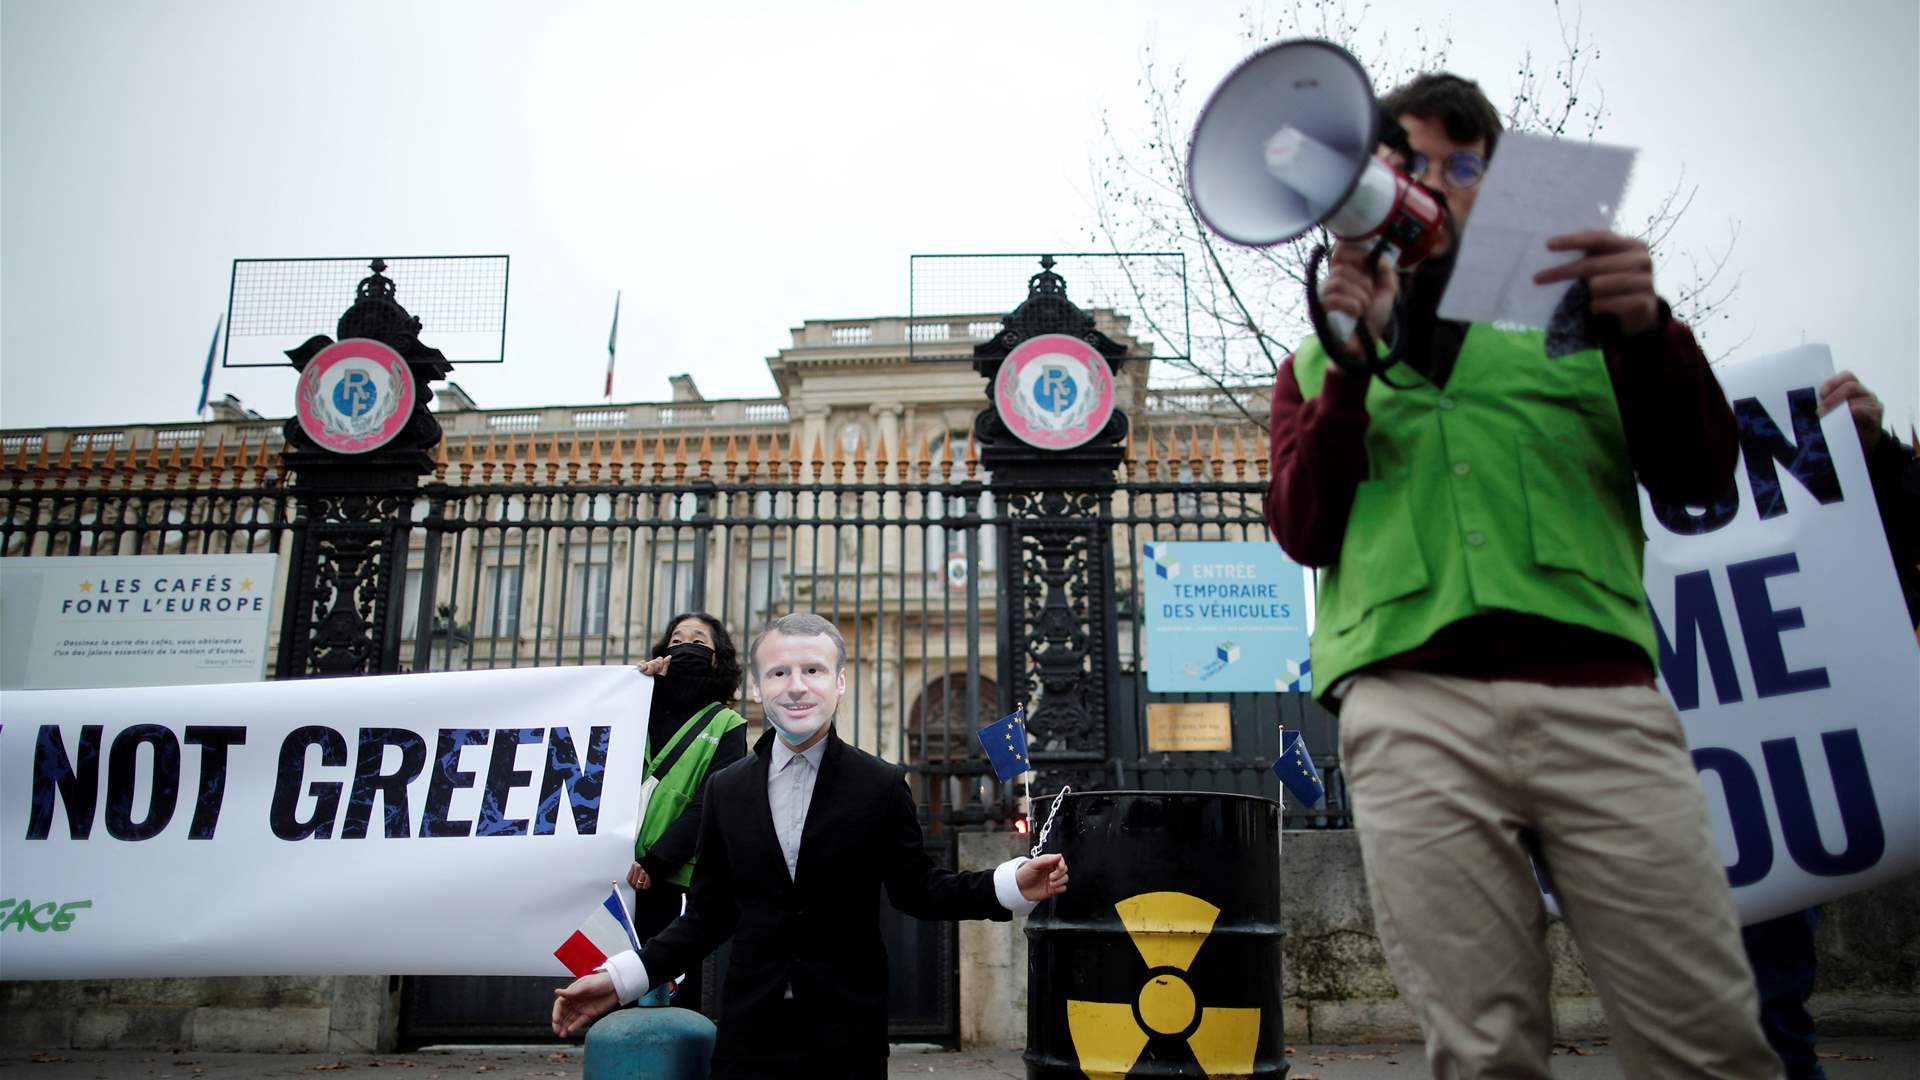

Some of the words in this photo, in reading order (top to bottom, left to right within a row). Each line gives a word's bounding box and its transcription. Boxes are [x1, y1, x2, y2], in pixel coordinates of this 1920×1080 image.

[1192, 561, 1257, 579] ENTRÉE
[100, 579, 141, 594] LES
[154, 575, 233, 593] CAFÉS
[1173, 584, 1278, 599] TEMPORAIRE
[62, 599, 130, 614] FONT
[143, 597, 264, 613] L'EUROPE
[1163, 604, 1194, 618] DES
[1199, 601, 1291, 618] VÉHICULES
[25, 724, 247, 842] NOT
[269, 725, 612, 842] GREEN
